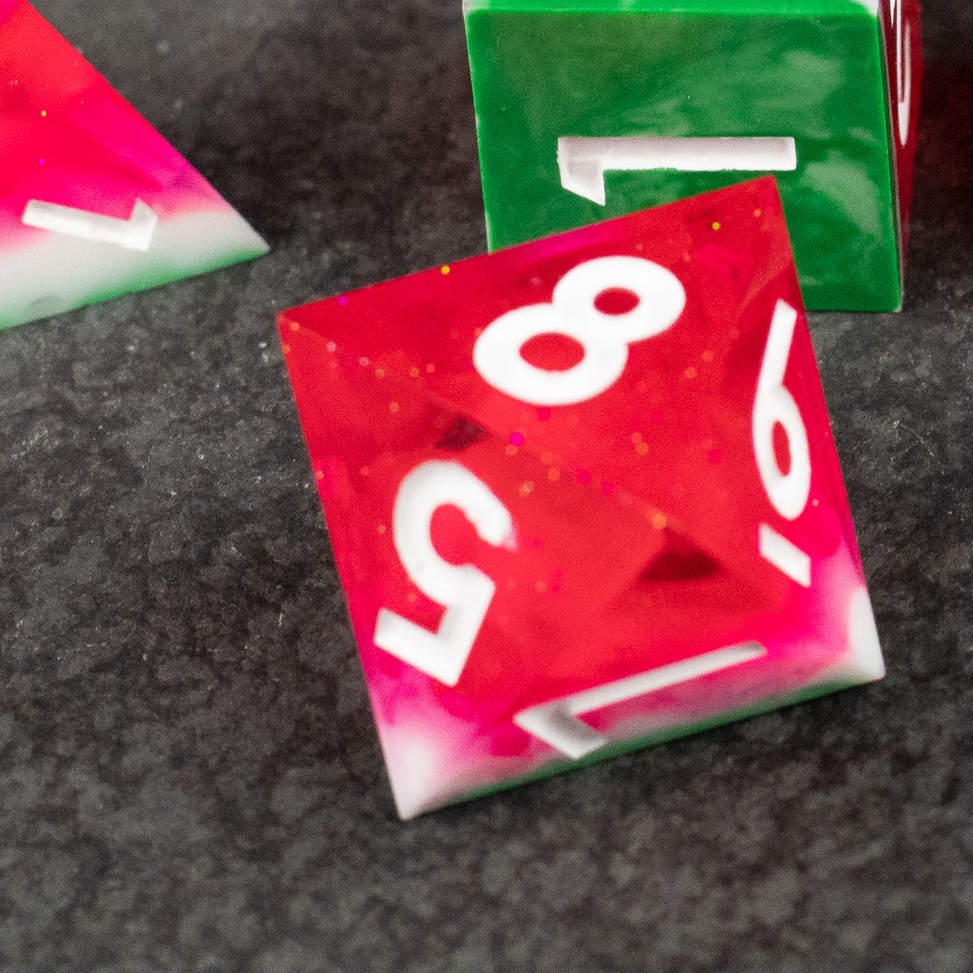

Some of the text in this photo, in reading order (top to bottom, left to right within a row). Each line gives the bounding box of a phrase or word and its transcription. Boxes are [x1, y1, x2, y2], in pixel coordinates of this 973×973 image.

[22, 197, 158, 252] 1
[556, 136, 797, 206] 1
[473, 255, 687, 406] 8
[373, 460, 518, 688] 5
